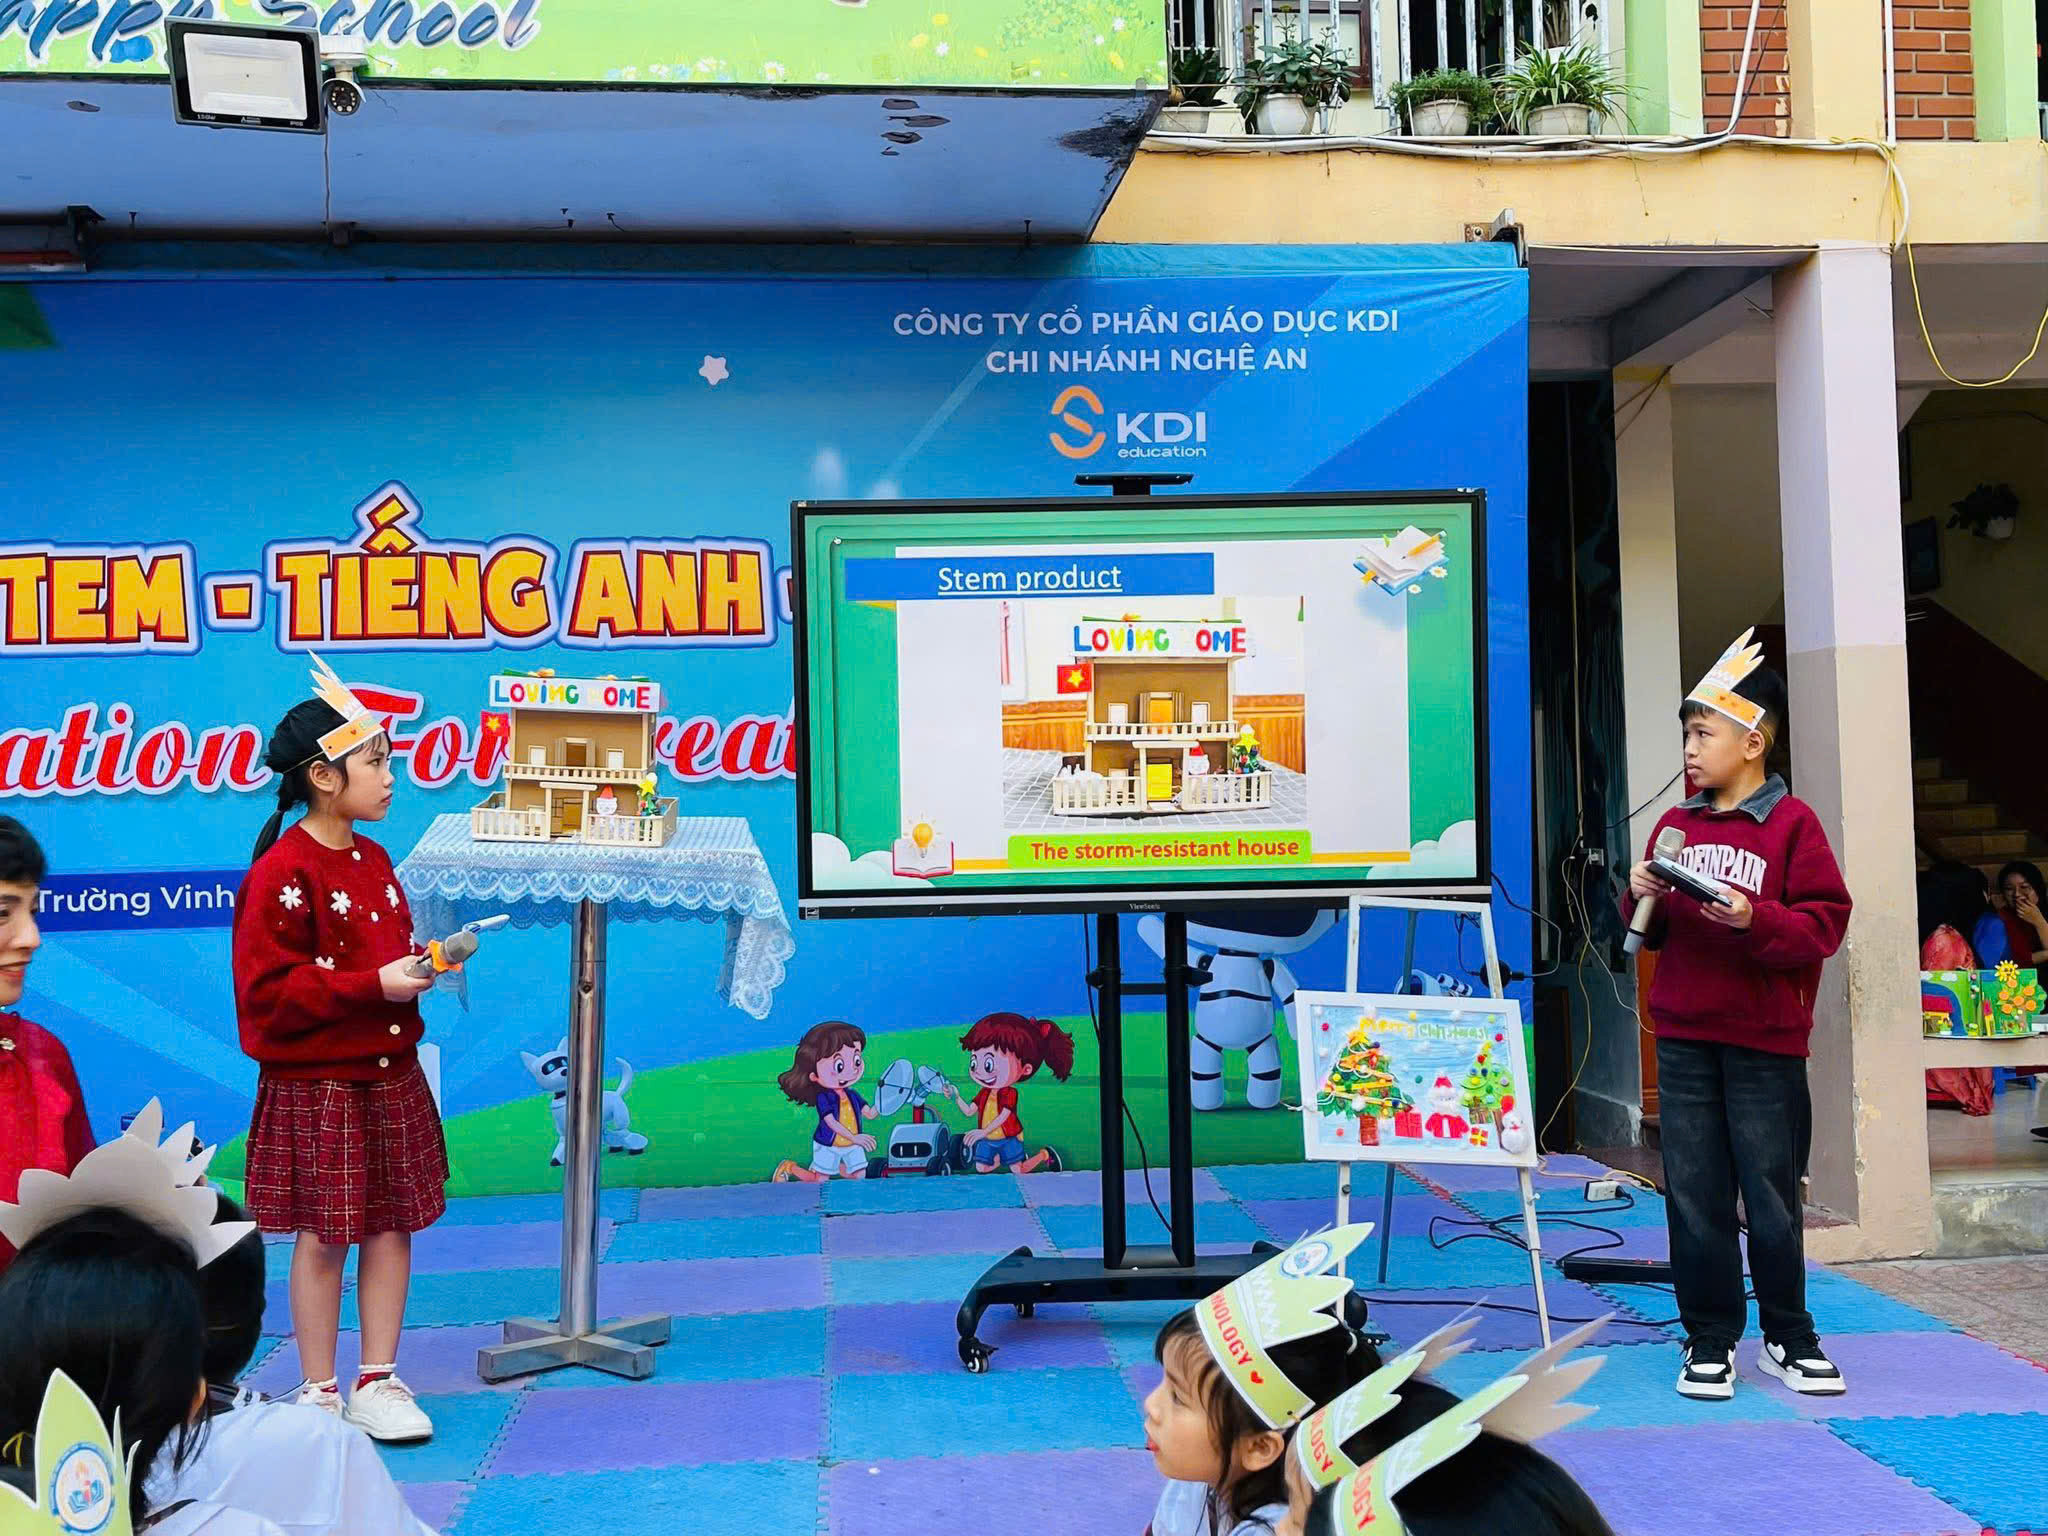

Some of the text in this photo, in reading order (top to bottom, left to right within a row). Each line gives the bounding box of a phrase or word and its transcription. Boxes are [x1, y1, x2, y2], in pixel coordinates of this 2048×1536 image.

[893, 304, 1398, 338] CÔNG TY CỔ PHẦN GIÁO DỤC KDI
[986, 342, 1307, 376] CHI NHÁNH NGHỆ AN
[1117, 411, 1206, 443] KDI
[1117, 446, 1207, 458] education
[0, 552, 190, 645] TEM
[276, 493, 551, 640] TIẾNG
[568, 549, 765, 638] ANH
[938, 564, 1122, 594] Stem product
[1195, 626, 1247, 653] OME
[1031, 838, 1300, 860] The storm-resistant house
[1679, 843, 1767, 896] DEINPAIN
[38, 883, 235, 916] Trường Vinh
